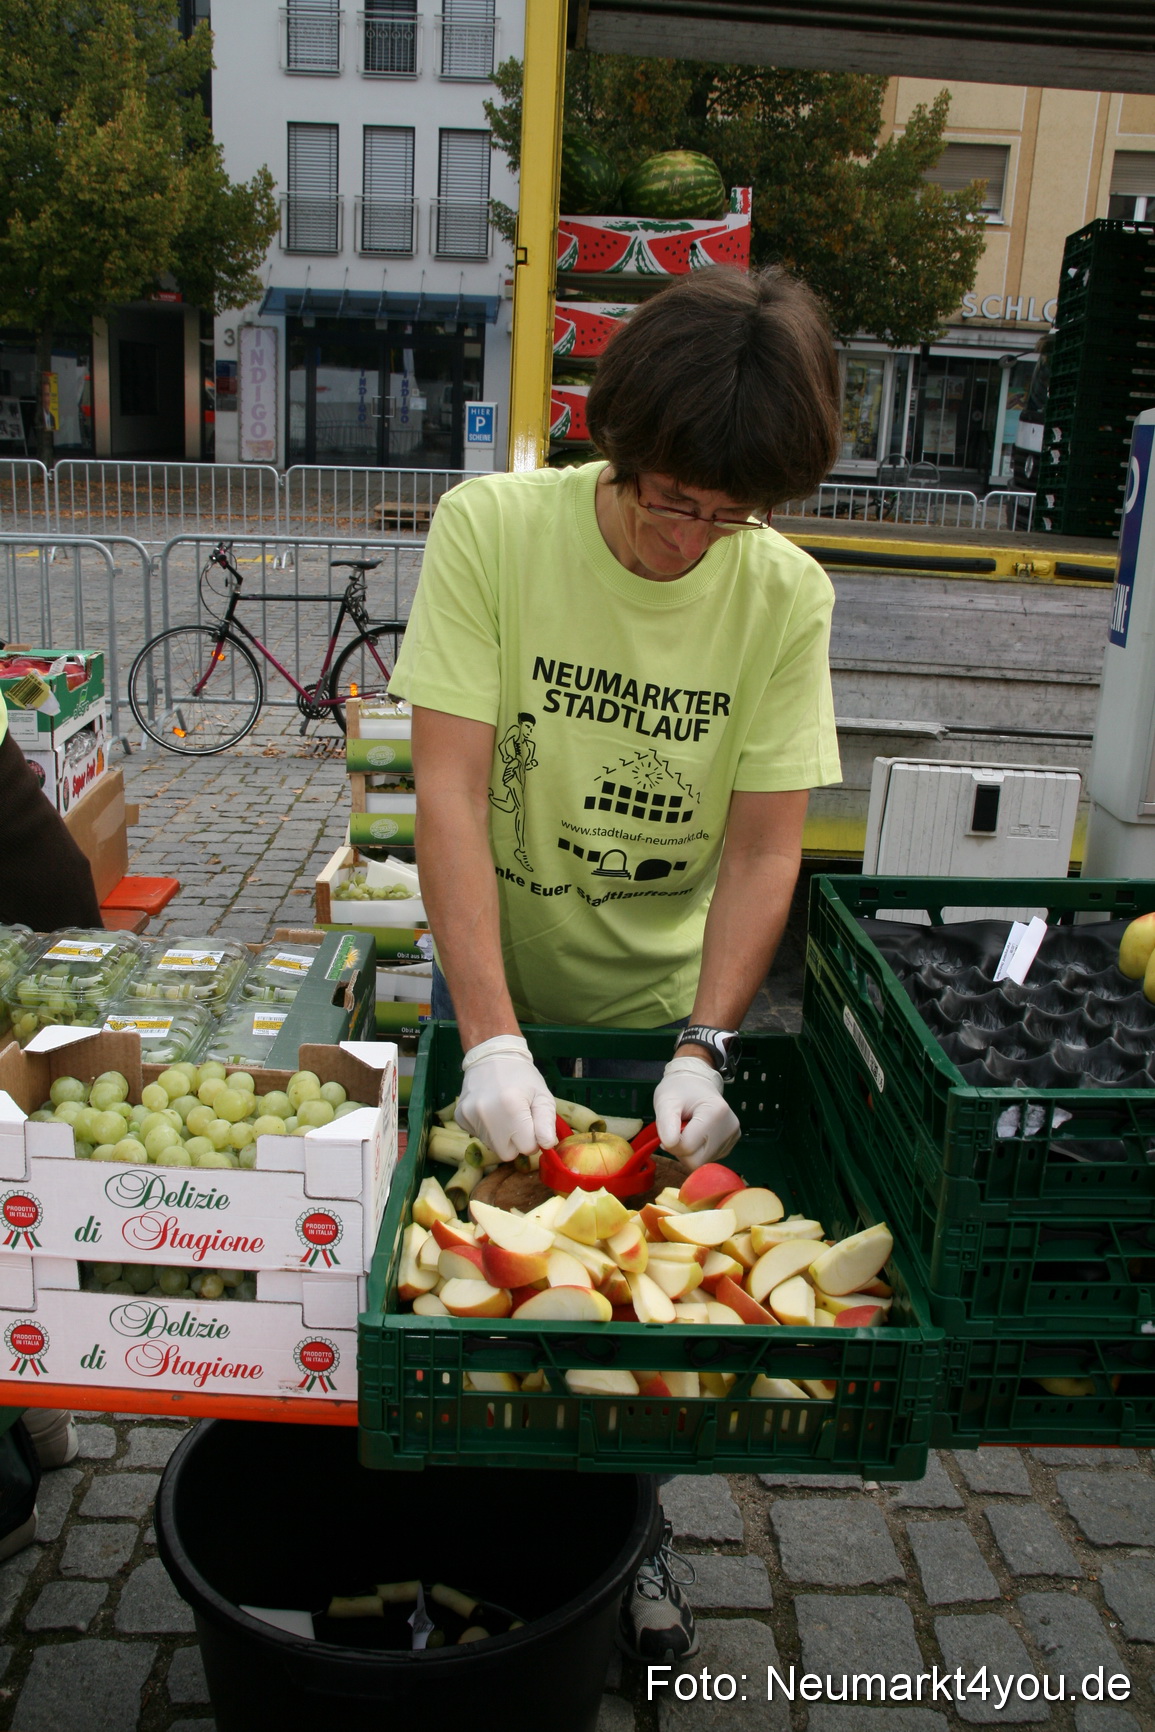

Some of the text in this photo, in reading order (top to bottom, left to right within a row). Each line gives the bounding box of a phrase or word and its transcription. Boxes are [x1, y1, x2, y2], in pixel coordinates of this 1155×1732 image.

[224, 328, 236, 347] 3
[250, 330, 267, 439] INDIGO
[358, 368, 367, 423] INDIGO
[401, 368, 410, 424] INDIGO
[471, 408, 491, 416] HIER
[475, 416, 486, 432] P
[469, 433, 492, 442] SCHEINE
[532, 656, 731, 717] NEUMARKTER
[543, 688, 710, 742] STADTLAUF
[561, 819, 710, 846] www.stadtlauf-neumarkt.de
[531, 881, 572, 897] Euer
[105, 1169, 231, 1210] Delizie
[74, 1211, 265, 1261] di Stagione
[109, 1300, 231, 1339] Delizie
[80, 1340, 264, 1387] di Stagione
